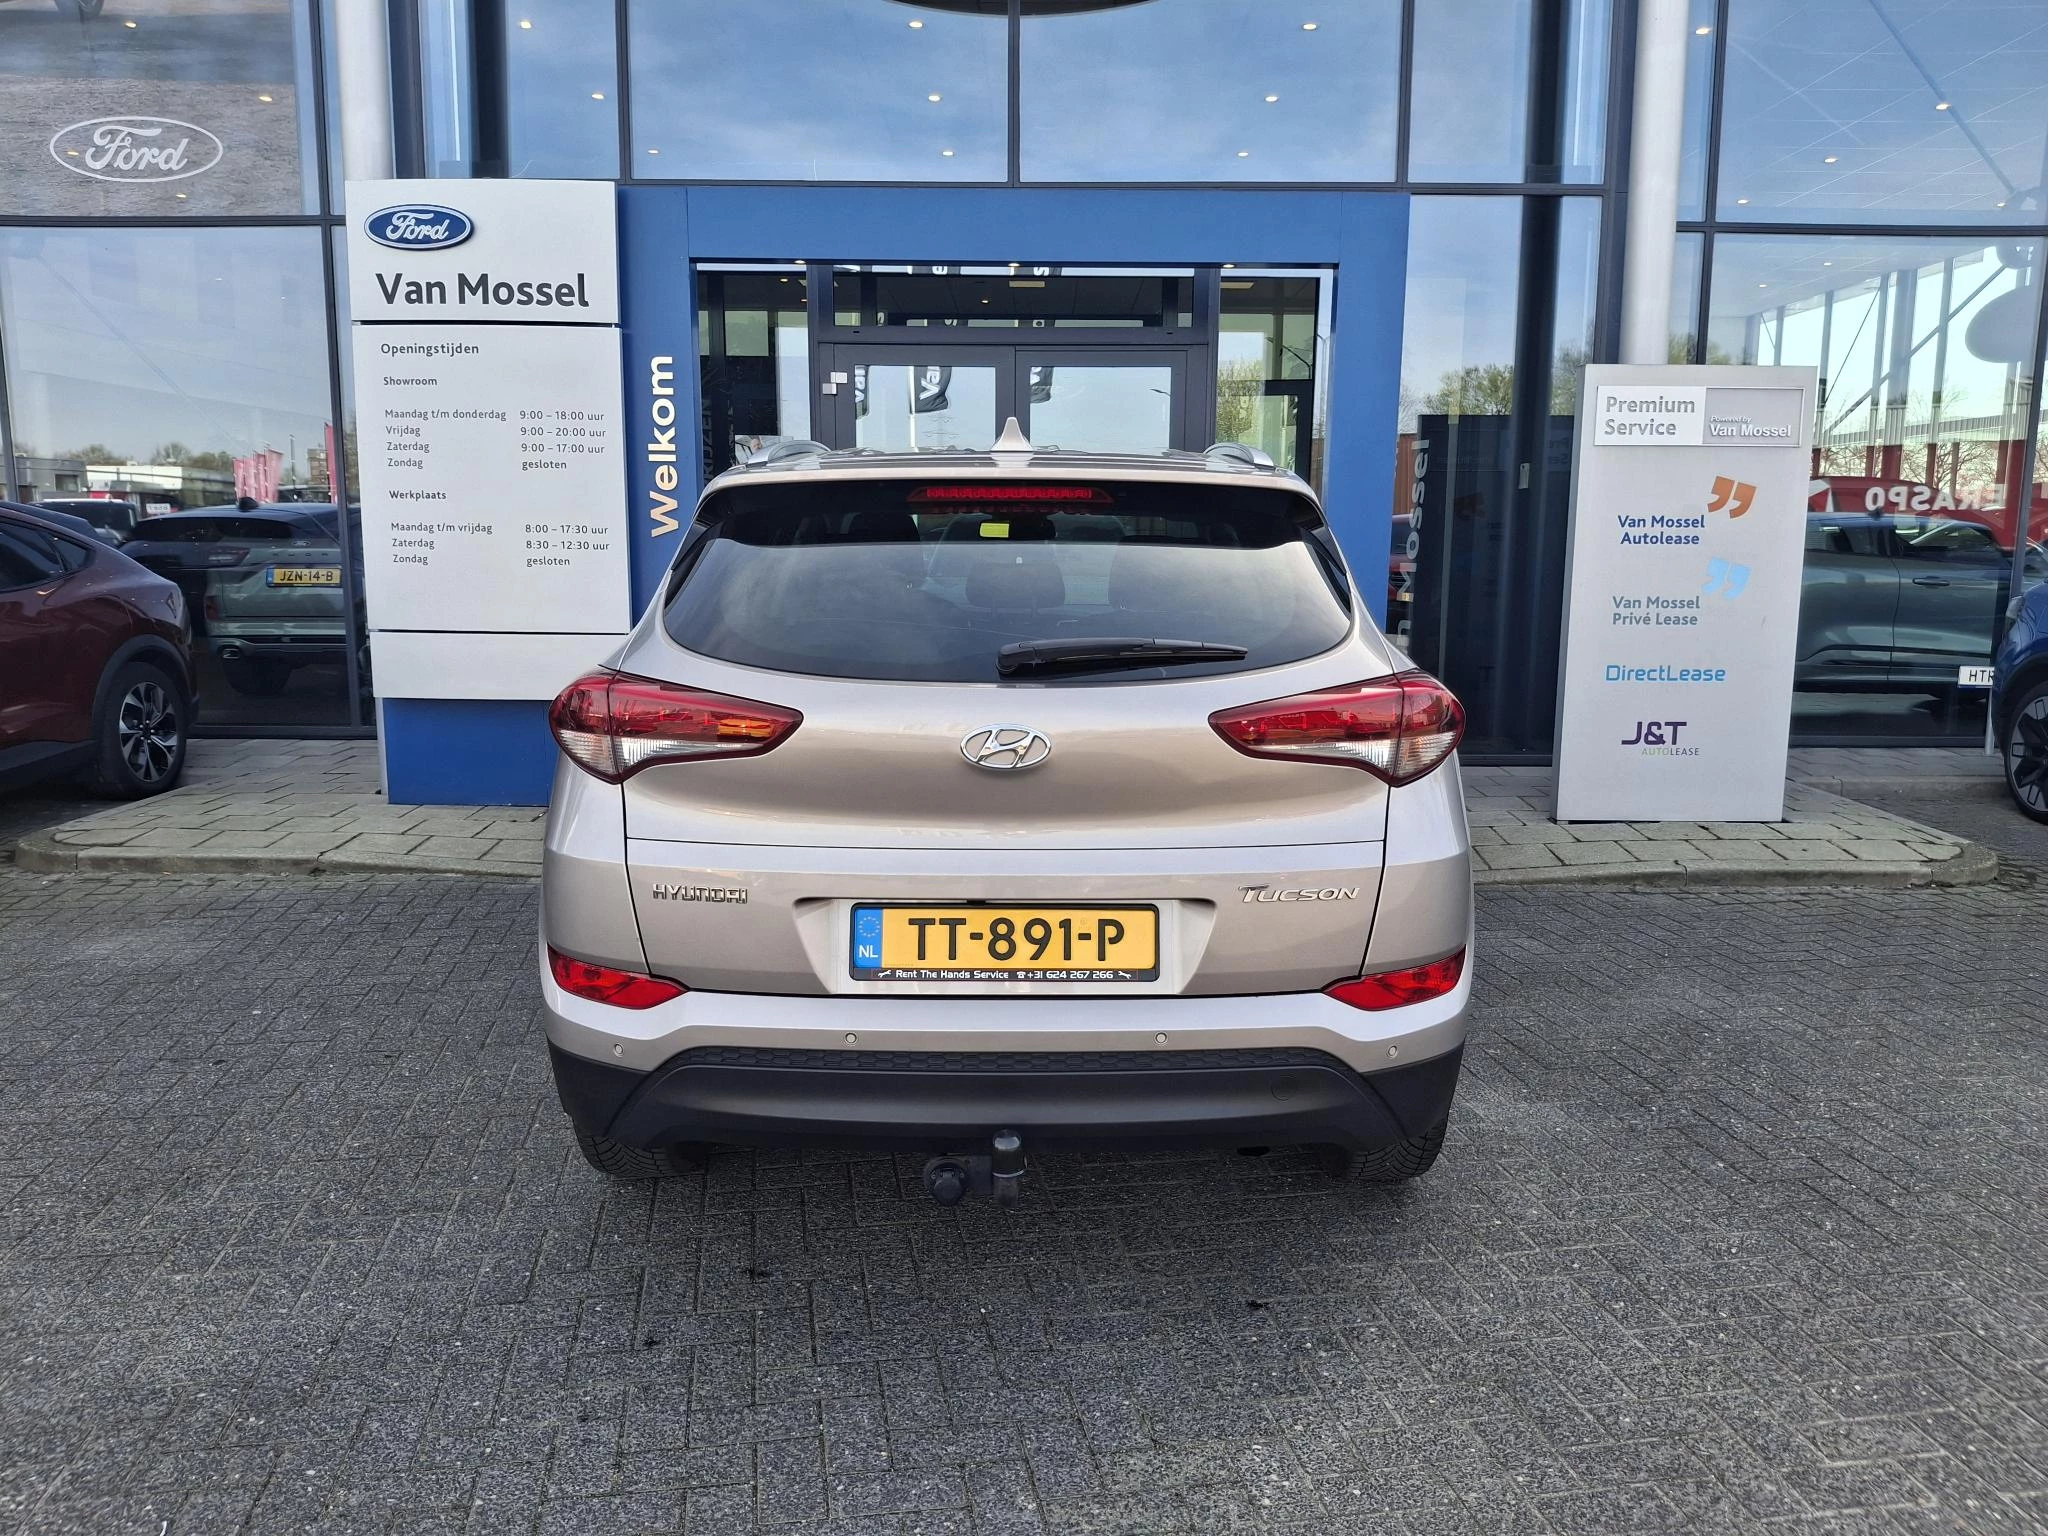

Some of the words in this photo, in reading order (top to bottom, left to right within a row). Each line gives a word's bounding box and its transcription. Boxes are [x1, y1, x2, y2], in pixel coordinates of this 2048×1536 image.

[84, 125, 190, 171] Ford
[385, 212, 450, 241] Ford
[375, 272, 447, 305] Van
[457, 272, 590, 308] Mossel
[380, 342, 479, 358] Openingstijden
[383, 375, 438, 386] Showroom
[1606, 395, 1695, 414] Premium
[384, 408, 429, 421] Maandag
[430, 408, 450, 419] t/m
[452, 408, 507, 422] donderdag
[519, 410, 544, 420] 9:00
[554, 410, 584, 421] 18:00
[587, 413, 605, 421] uur
[385, 424, 421, 438] Vrijdag
[520, 426, 544, 436] 9:00
[555, 427, 586, 437] 20:00
[1604, 417, 1677, 436] Service
[1709, 423, 1736, 438] Van
[1740, 424, 1792, 438] Mossel
[386, 441, 430, 454] Zaterdag
[521, 442, 545, 453] 9:00
[556, 443, 585, 454] 17:00
[587, 446, 605, 454] uur
[648, 356, 679, 538] Welkom
[387, 457, 424, 470] Zondag
[521, 459, 567, 472] gesloten
[388, 489, 447, 502] Werkplaats
[390, 522, 435, 535] Maandag
[436, 522, 456, 532] t/m
[457, 522, 493, 535] vrijdag
[525, 523, 549, 534] 8:00
[559, 524, 588, 534] 17:30
[591, 527, 609, 535] uur
[1397, 439, 1430, 603] Mossel
[1617, 514, 1647, 528] Van
[1650, 514, 1705, 529] Mossel
[391, 537, 435, 551] Zaterdag
[526, 540, 549, 550] 8:30
[560, 540, 590, 550] 12:30
[592, 543, 610, 551] uur
[1620, 530, 1700, 545] Autolease
[392, 553, 429, 566] Zondag
[526, 555, 571, 568] gesloten
[280, 570, 333, 582] JZN-14-B
[1612, 595, 1642, 609] Van
[1646, 595, 1701, 609] Mossel
[1612, 611, 1652, 626] Privé
[1655, 612, 1698, 626] Lease
[1605, 664, 1726, 682] DirectLease
[1621, 721, 1688, 746] J&T
[1641, 748, 1700, 757] AUTOLEASE
[653, 884, 748, 904] HYUNDAI
[908, 917, 1125, 962] TT-891-P
[858, 944, 879, 959] NL
[895, 969, 918, 979] Rent
[921, 969, 938, 979] The
[940, 969, 970, 979] Hands
[973, 969, 1009, 979] Service
[1027, 970, 1044, 979] +31
[1046, 970, 1067, 979] 624
[1070, 970, 1090, 979] 267
[1092, 970, 1114, 979] 266
